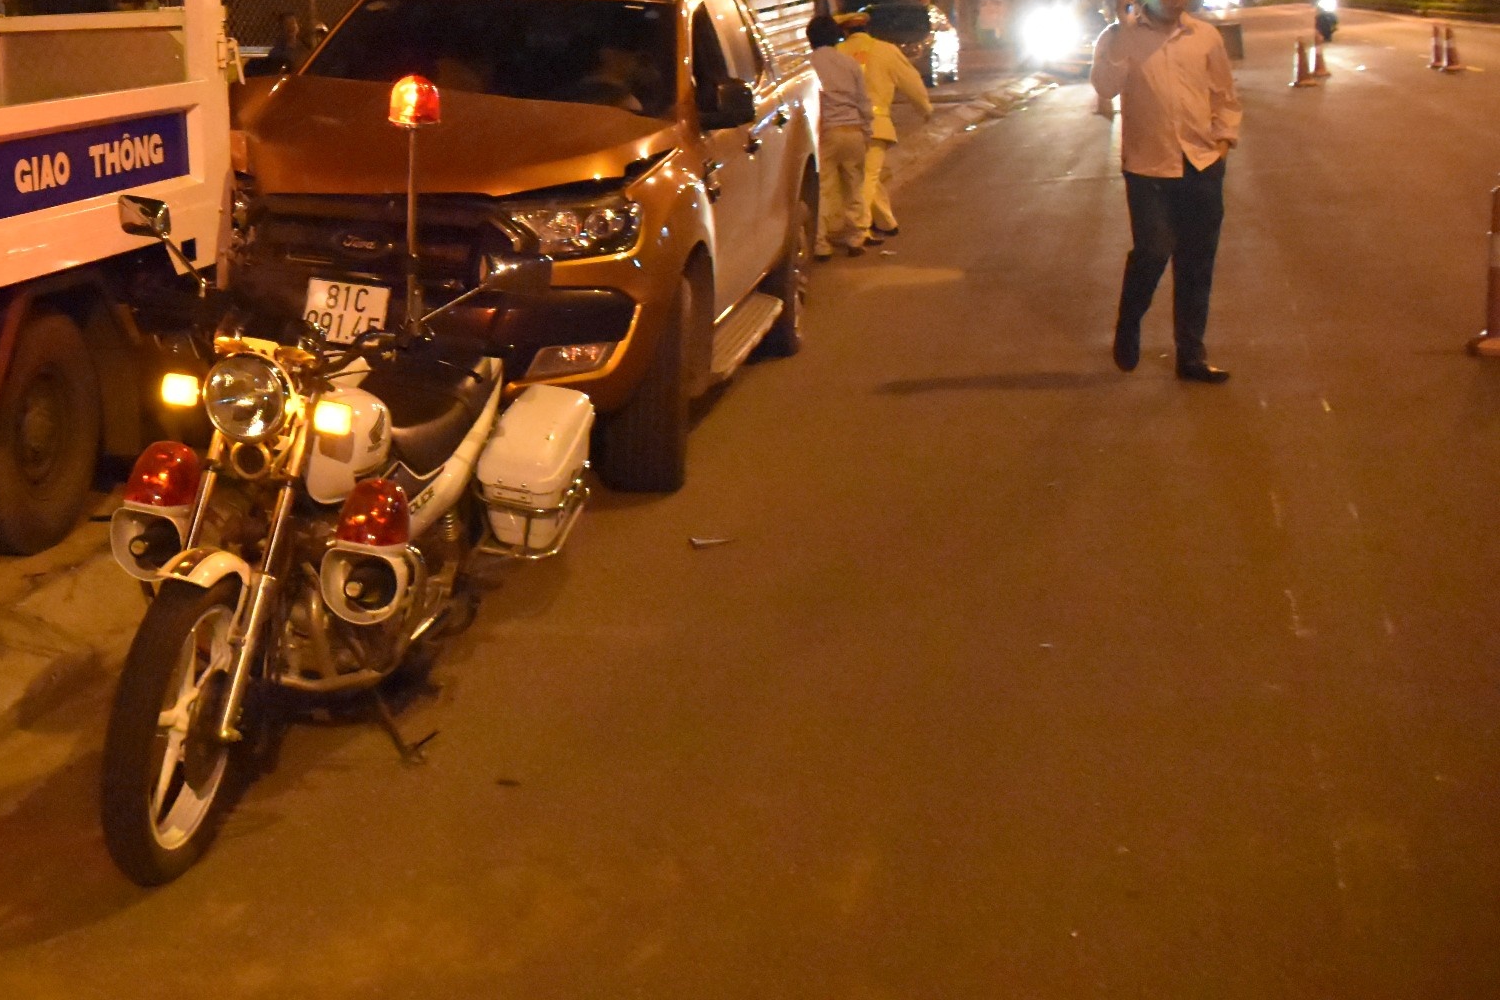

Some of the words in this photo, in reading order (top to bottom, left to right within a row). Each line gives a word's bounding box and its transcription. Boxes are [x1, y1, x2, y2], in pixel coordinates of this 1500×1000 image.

[14, 151, 72, 194] GIAO
[88, 132, 165, 178] THÔNG
[325, 284, 369, 313] 81C
